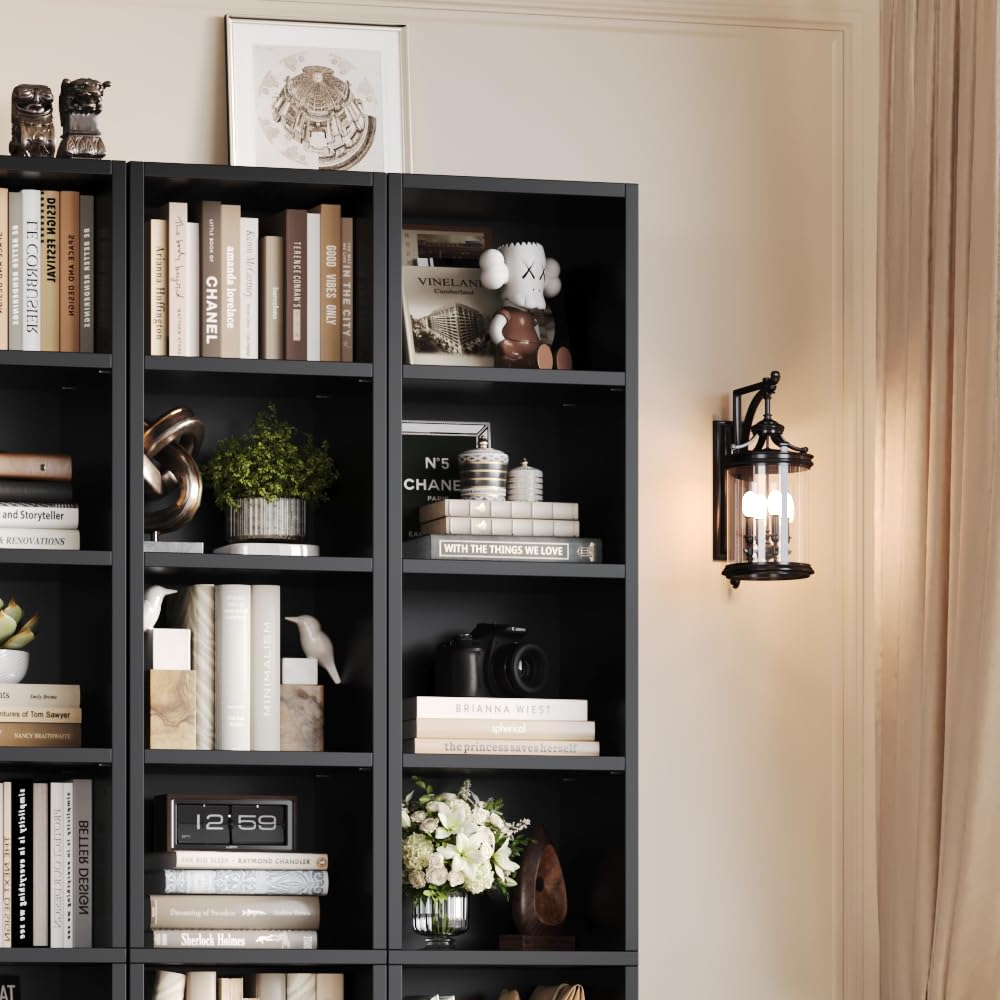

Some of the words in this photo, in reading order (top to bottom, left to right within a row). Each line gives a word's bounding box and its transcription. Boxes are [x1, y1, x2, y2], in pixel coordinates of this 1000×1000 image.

[293, 242, 302, 275] TERENCE
[326, 245, 337, 268] GOOD
[342, 263, 351, 279] IN
[326, 273, 337, 299] VIBES
[418, 277, 482, 288] VINELAN
[293, 275, 302, 309] CONRAN'S
[342, 282, 351, 305] THE
[206, 276, 218, 344] CHANEL
[227, 288, 237, 329] lovelace
[326, 304, 337, 326] ONLY
[342, 309, 351, 338] CITY
[403, 478, 461, 491] CHANE
[2, 510, 18, 520] and
[20, 511, 64, 522] Storyteller
[6, 536, 66, 545] RENOVATIONS
[444, 543, 468, 554] WITH
[470, 544, 488, 554] THE
[489, 545, 523, 555] THINGS
[525, 545, 539, 555] WE
[541, 546, 564, 556] LOVE
[46, 711, 71, 720] Sawyer
[456, 704, 510, 713] BRIANNA
[517, 705, 552, 714] WIEST
[445, 742, 462, 752] the
[464, 743, 509, 753] princess
[238, 857, 273, 865] RAYMOND
[181, 933, 216, 946] Sherlock
[217, 933, 246, 946] Holmes
